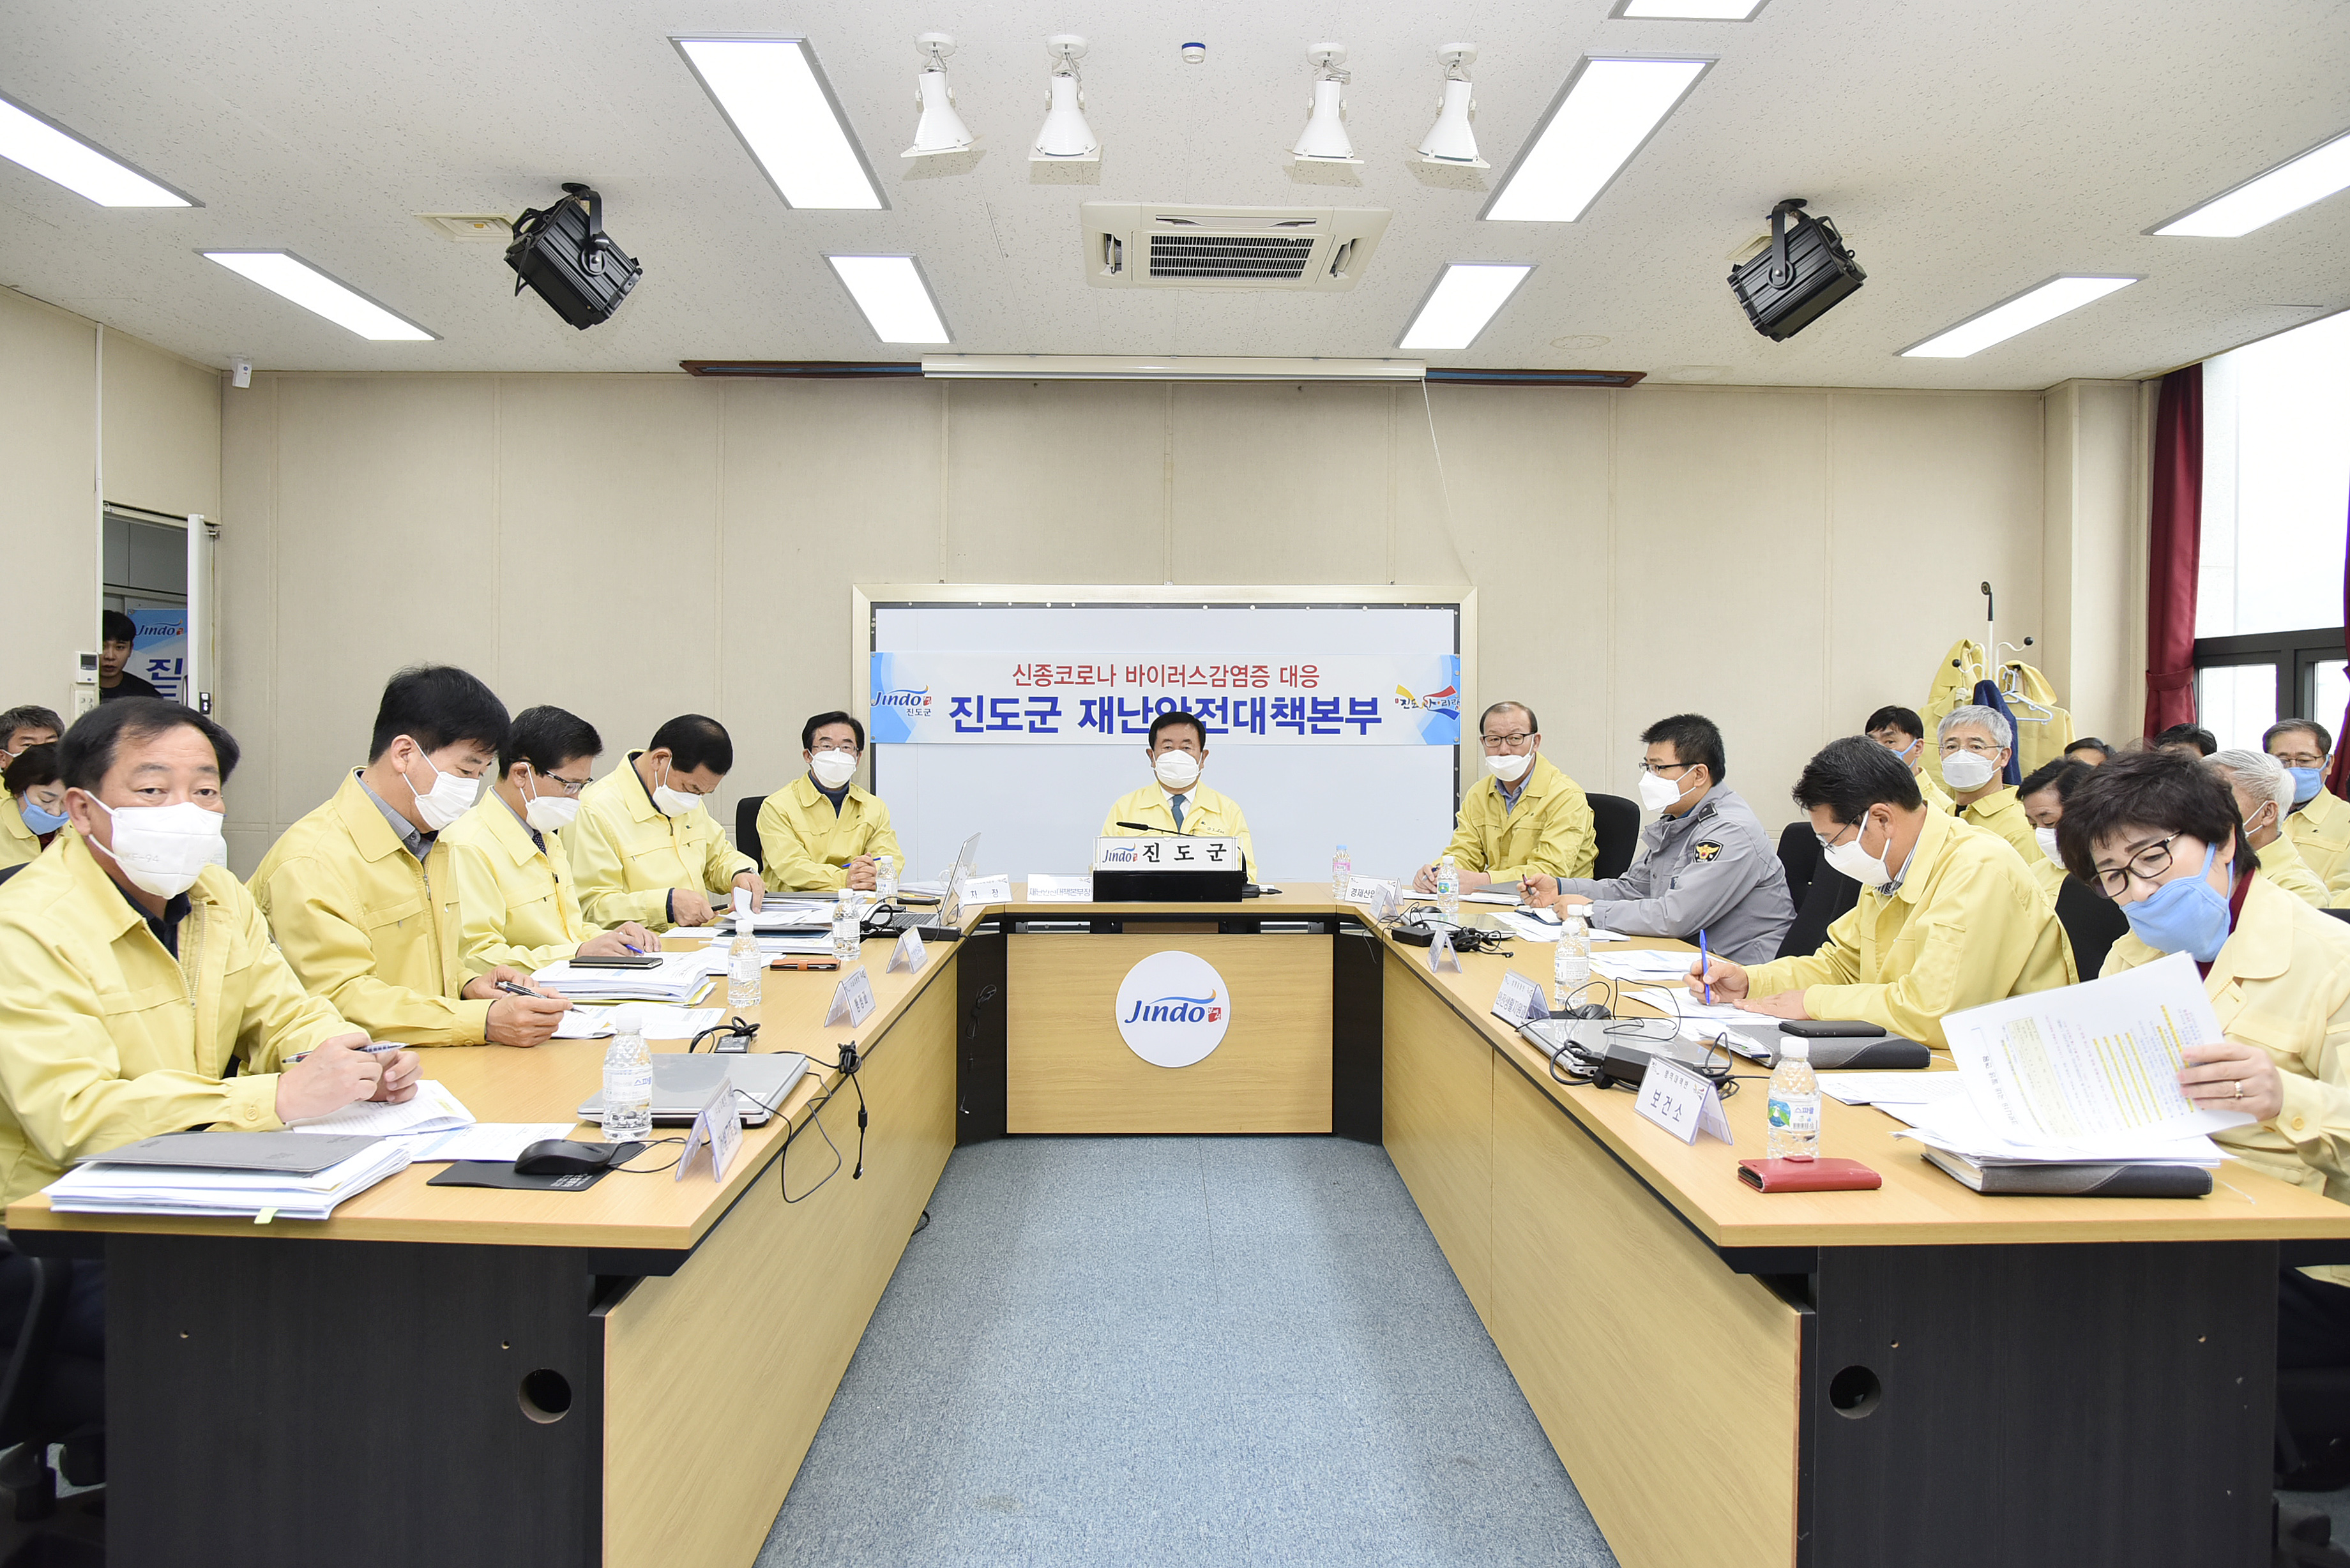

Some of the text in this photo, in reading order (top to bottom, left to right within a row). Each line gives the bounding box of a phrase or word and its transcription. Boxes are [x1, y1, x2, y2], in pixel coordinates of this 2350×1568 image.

[136, 625, 176, 636] Jindo
[1012, 663, 1320, 688] 신종코로나 바이러스감염증 대응
[871, 692, 921, 707] Jindo
[906, 709, 932, 717] 진도군
[949, 695, 1062, 734] 진도군
[1102, 849, 1132, 863] Jindo
[1124, 1000, 1206, 1023] Jindo
[1650, 1089, 1683, 1122] 보건소
